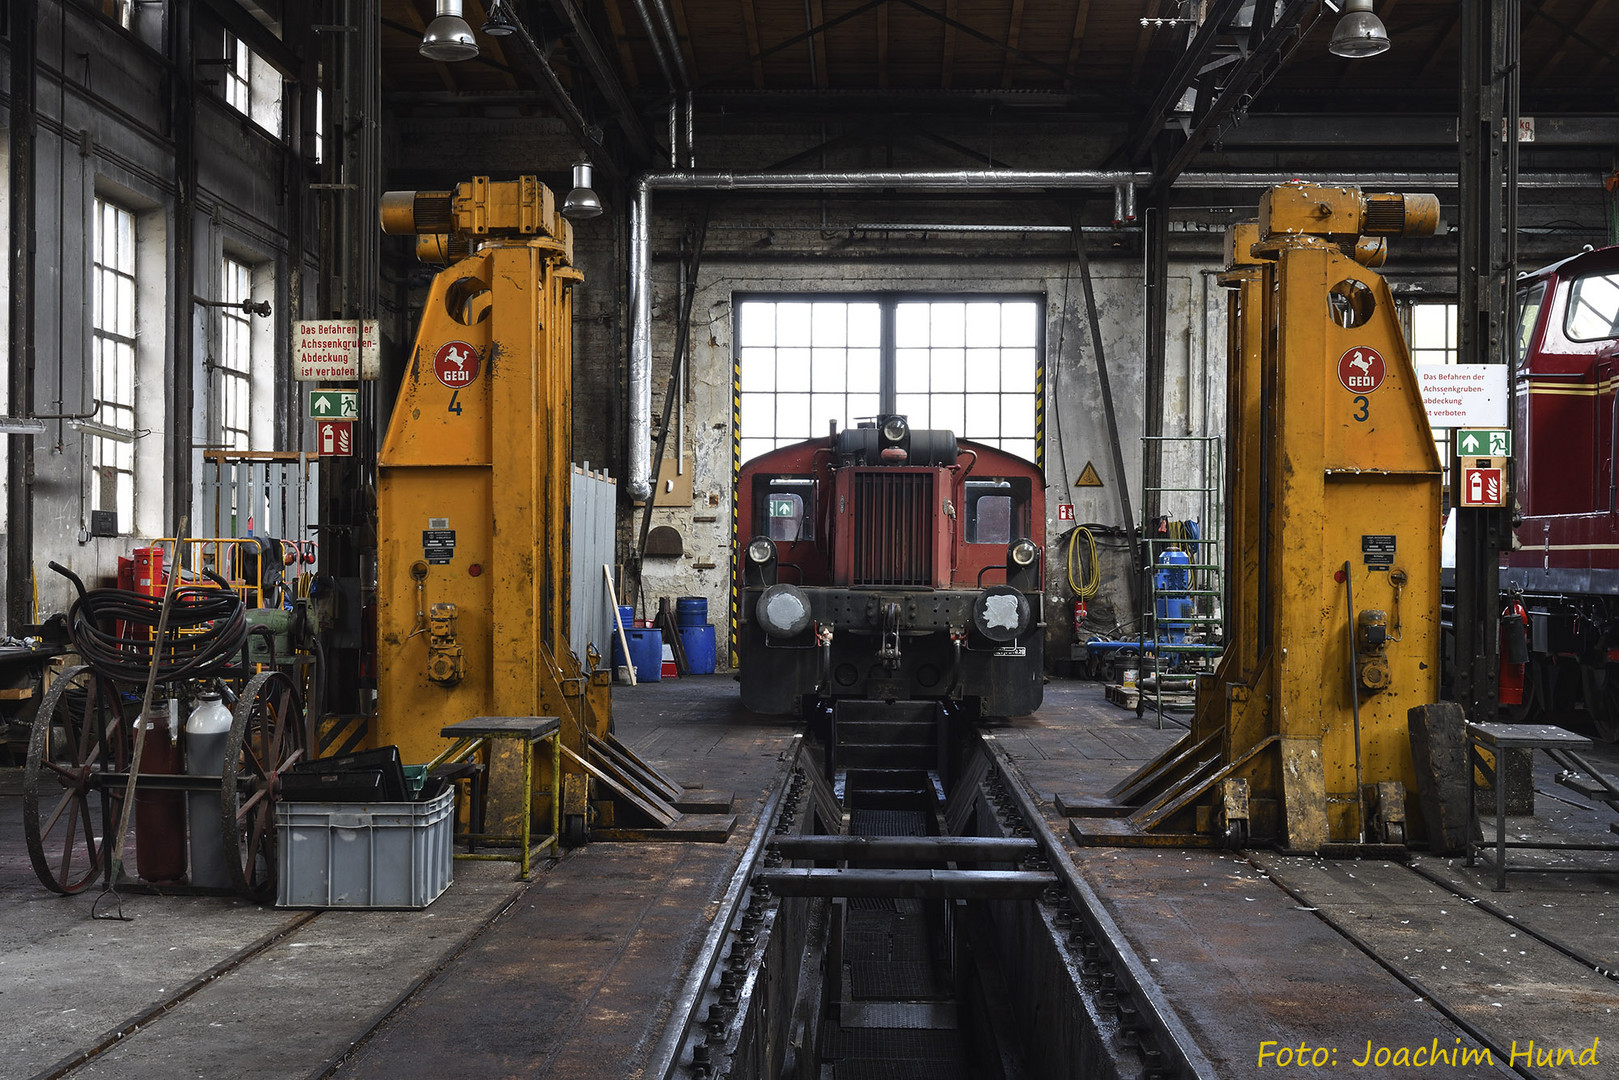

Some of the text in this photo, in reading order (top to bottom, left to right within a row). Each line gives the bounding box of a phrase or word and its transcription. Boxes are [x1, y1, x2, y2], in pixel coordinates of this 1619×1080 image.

[1519, 119, 1530, 131] kg
[301, 324, 316, 335] Das
[318, 324, 357, 335] Befahren
[301, 338, 377, 351] Achssenkgruen-
[301, 352, 348, 365] Abdeckung
[301, 367, 314, 377] ist
[444, 370, 469, 381] GEDI
[1348, 376, 1374, 387] GEDI
[1423, 385, 1485, 393] Achssenkgruben-
[448, 390, 463, 416] 4
[1423, 397, 1462, 406] abdeckung
[1353, 395, 1370, 423] 3
